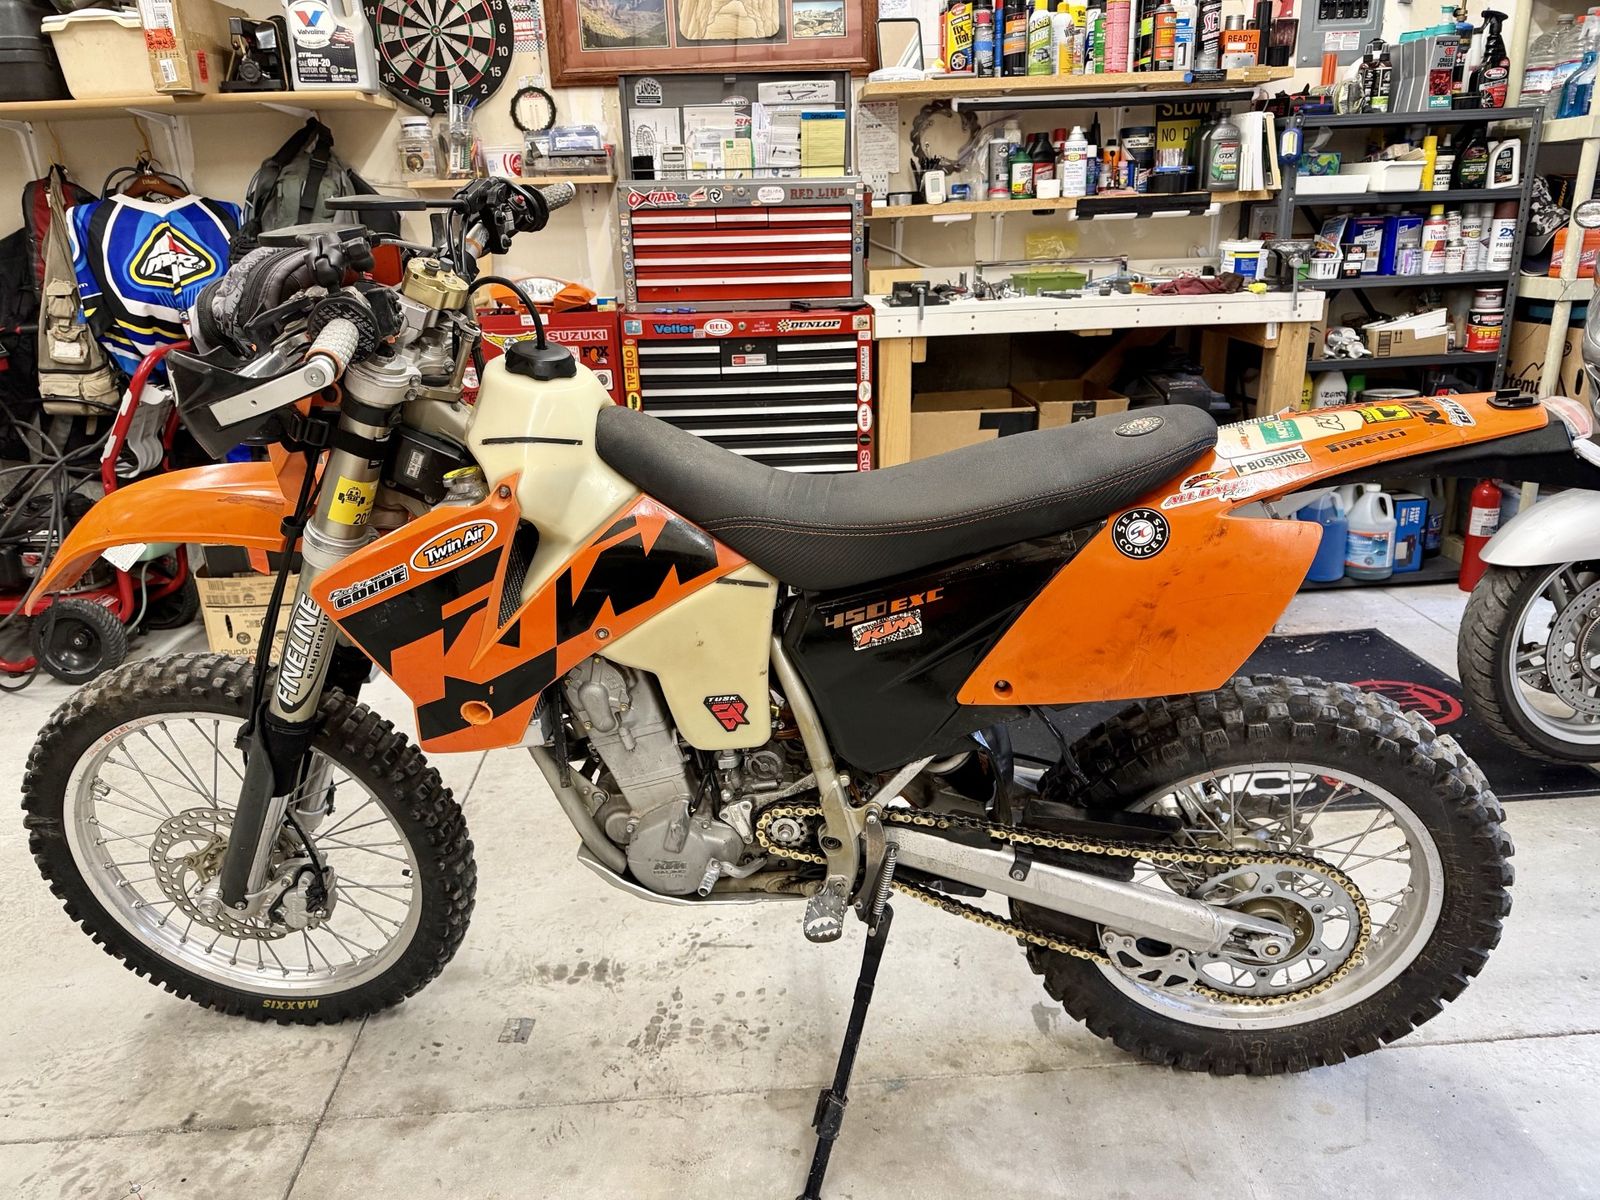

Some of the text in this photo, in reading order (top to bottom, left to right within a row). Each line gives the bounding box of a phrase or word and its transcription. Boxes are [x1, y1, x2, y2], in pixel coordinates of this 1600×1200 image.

[365, 7, 376, 16] 14
[499, 24, 507, 33] 6
[952, 24, 964, 35] fix
[1227, 34, 1253, 42] READY
[496, 47, 509, 57] 10
[307, 58, 331, 67] 0W-20
[383, 73, 395, 83] 16
[490, 67, 501, 77] 15
[481, 84, 488, 94] 2
[420, 97, 432, 107] 19
[1162, 102, 1211, 117] SLOW
[1161, 128, 1177, 142] NO
[789, 189, 814, 200] RED
[818, 187, 846, 198] LINE
[653, 323, 695, 335] Vetter
[790, 320, 840, 329] DUNLOP
[547, 330, 608, 341] SUZUKI
[582, 345, 609, 362] FOX
[1325, 429, 1407, 453] PIRELLI
[1247, 450, 1308, 471] BUSHING
[1116, 511, 1151, 534] SEAT
[424, 537, 462, 563] Twin
[463, 525, 485, 546] Air
[336, 570, 407, 608] GOLDE
[890, 586, 944, 613] EXC
[858, 615, 918, 646] KTM
[277, 591, 322, 707] FINELINE
[307, 613, 330, 680] suspensio
[103, 724, 133, 743] EXCEL
[262, 999, 319, 1010] MAXXIS
